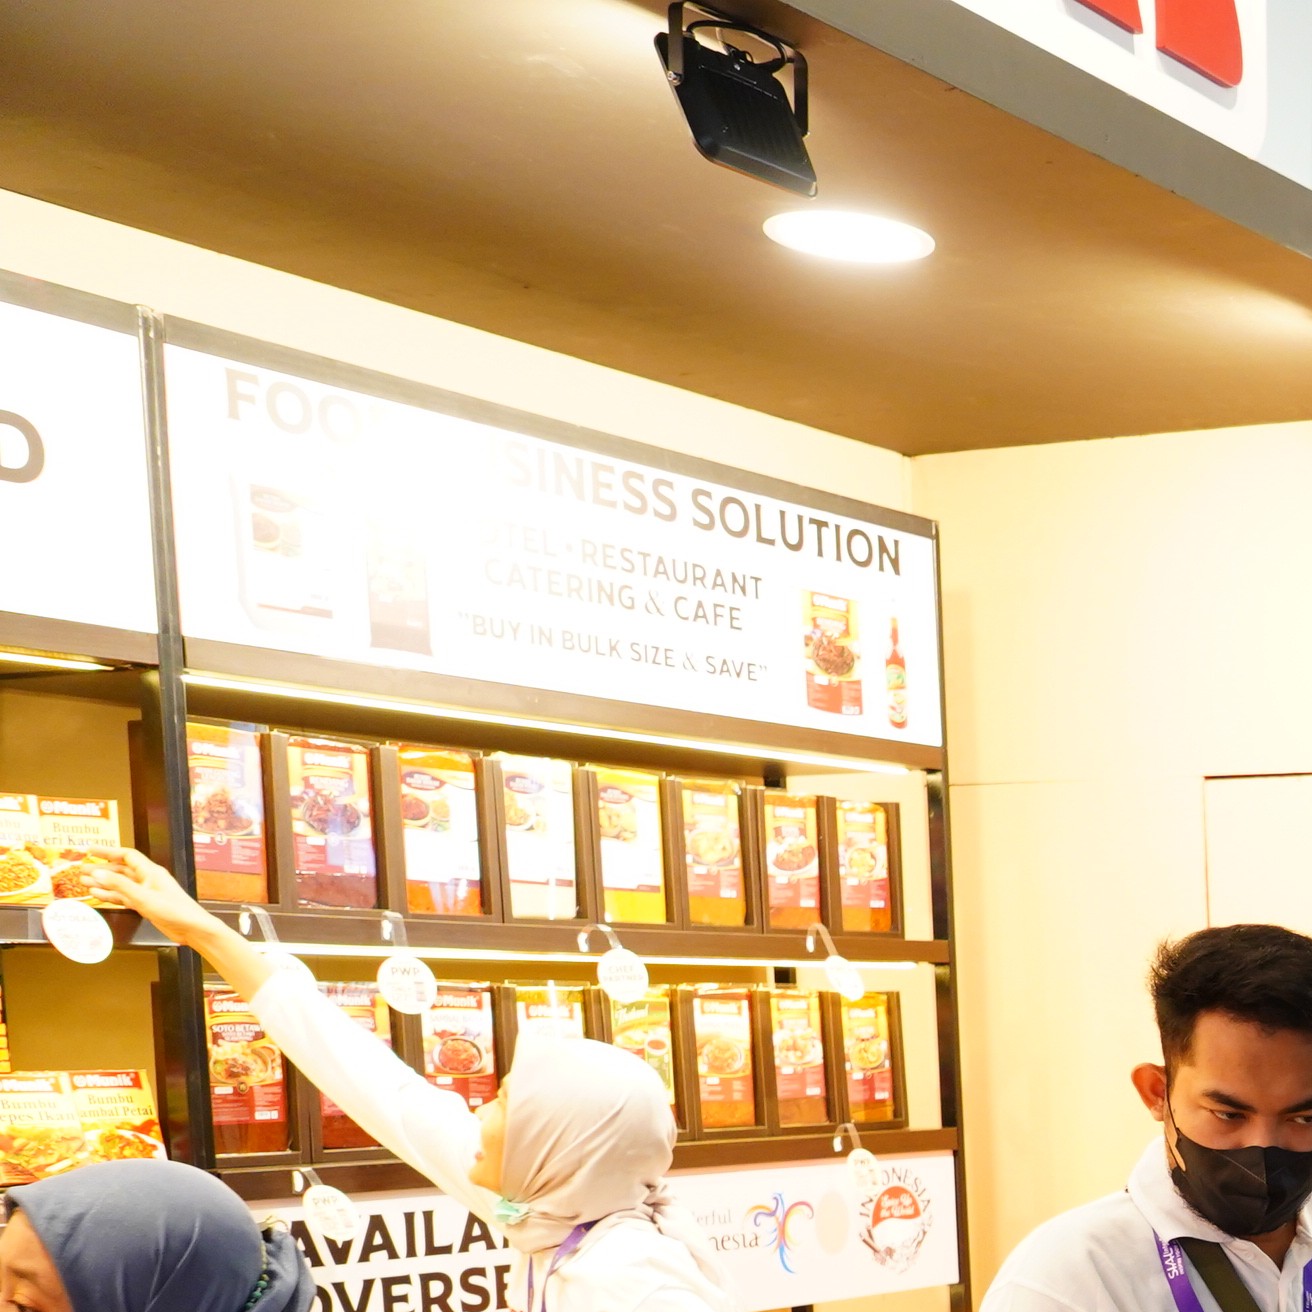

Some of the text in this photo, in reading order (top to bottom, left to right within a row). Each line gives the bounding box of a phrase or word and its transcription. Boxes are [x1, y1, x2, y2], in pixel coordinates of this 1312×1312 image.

[225, 367, 900, 576] FOO SINESS SOLUTION
[581, 538, 762, 600] RESTAURANT
[484, 558, 743, 631] CATERING & CAFE
[531, 624, 553, 647] IN
[561, 630, 621, 658] BULK
[630, 642, 676, 667] SIZE
[43, 836, 62, 845] eri
[52, 822, 100, 835] Bumbu
[80, 1104, 154, 1119] ambal Petai
[88, 1093, 134, 1105] Bumbu
[0, 1111, 34, 1126] epes
[290, 1210, 509, 1268] AVAILA
